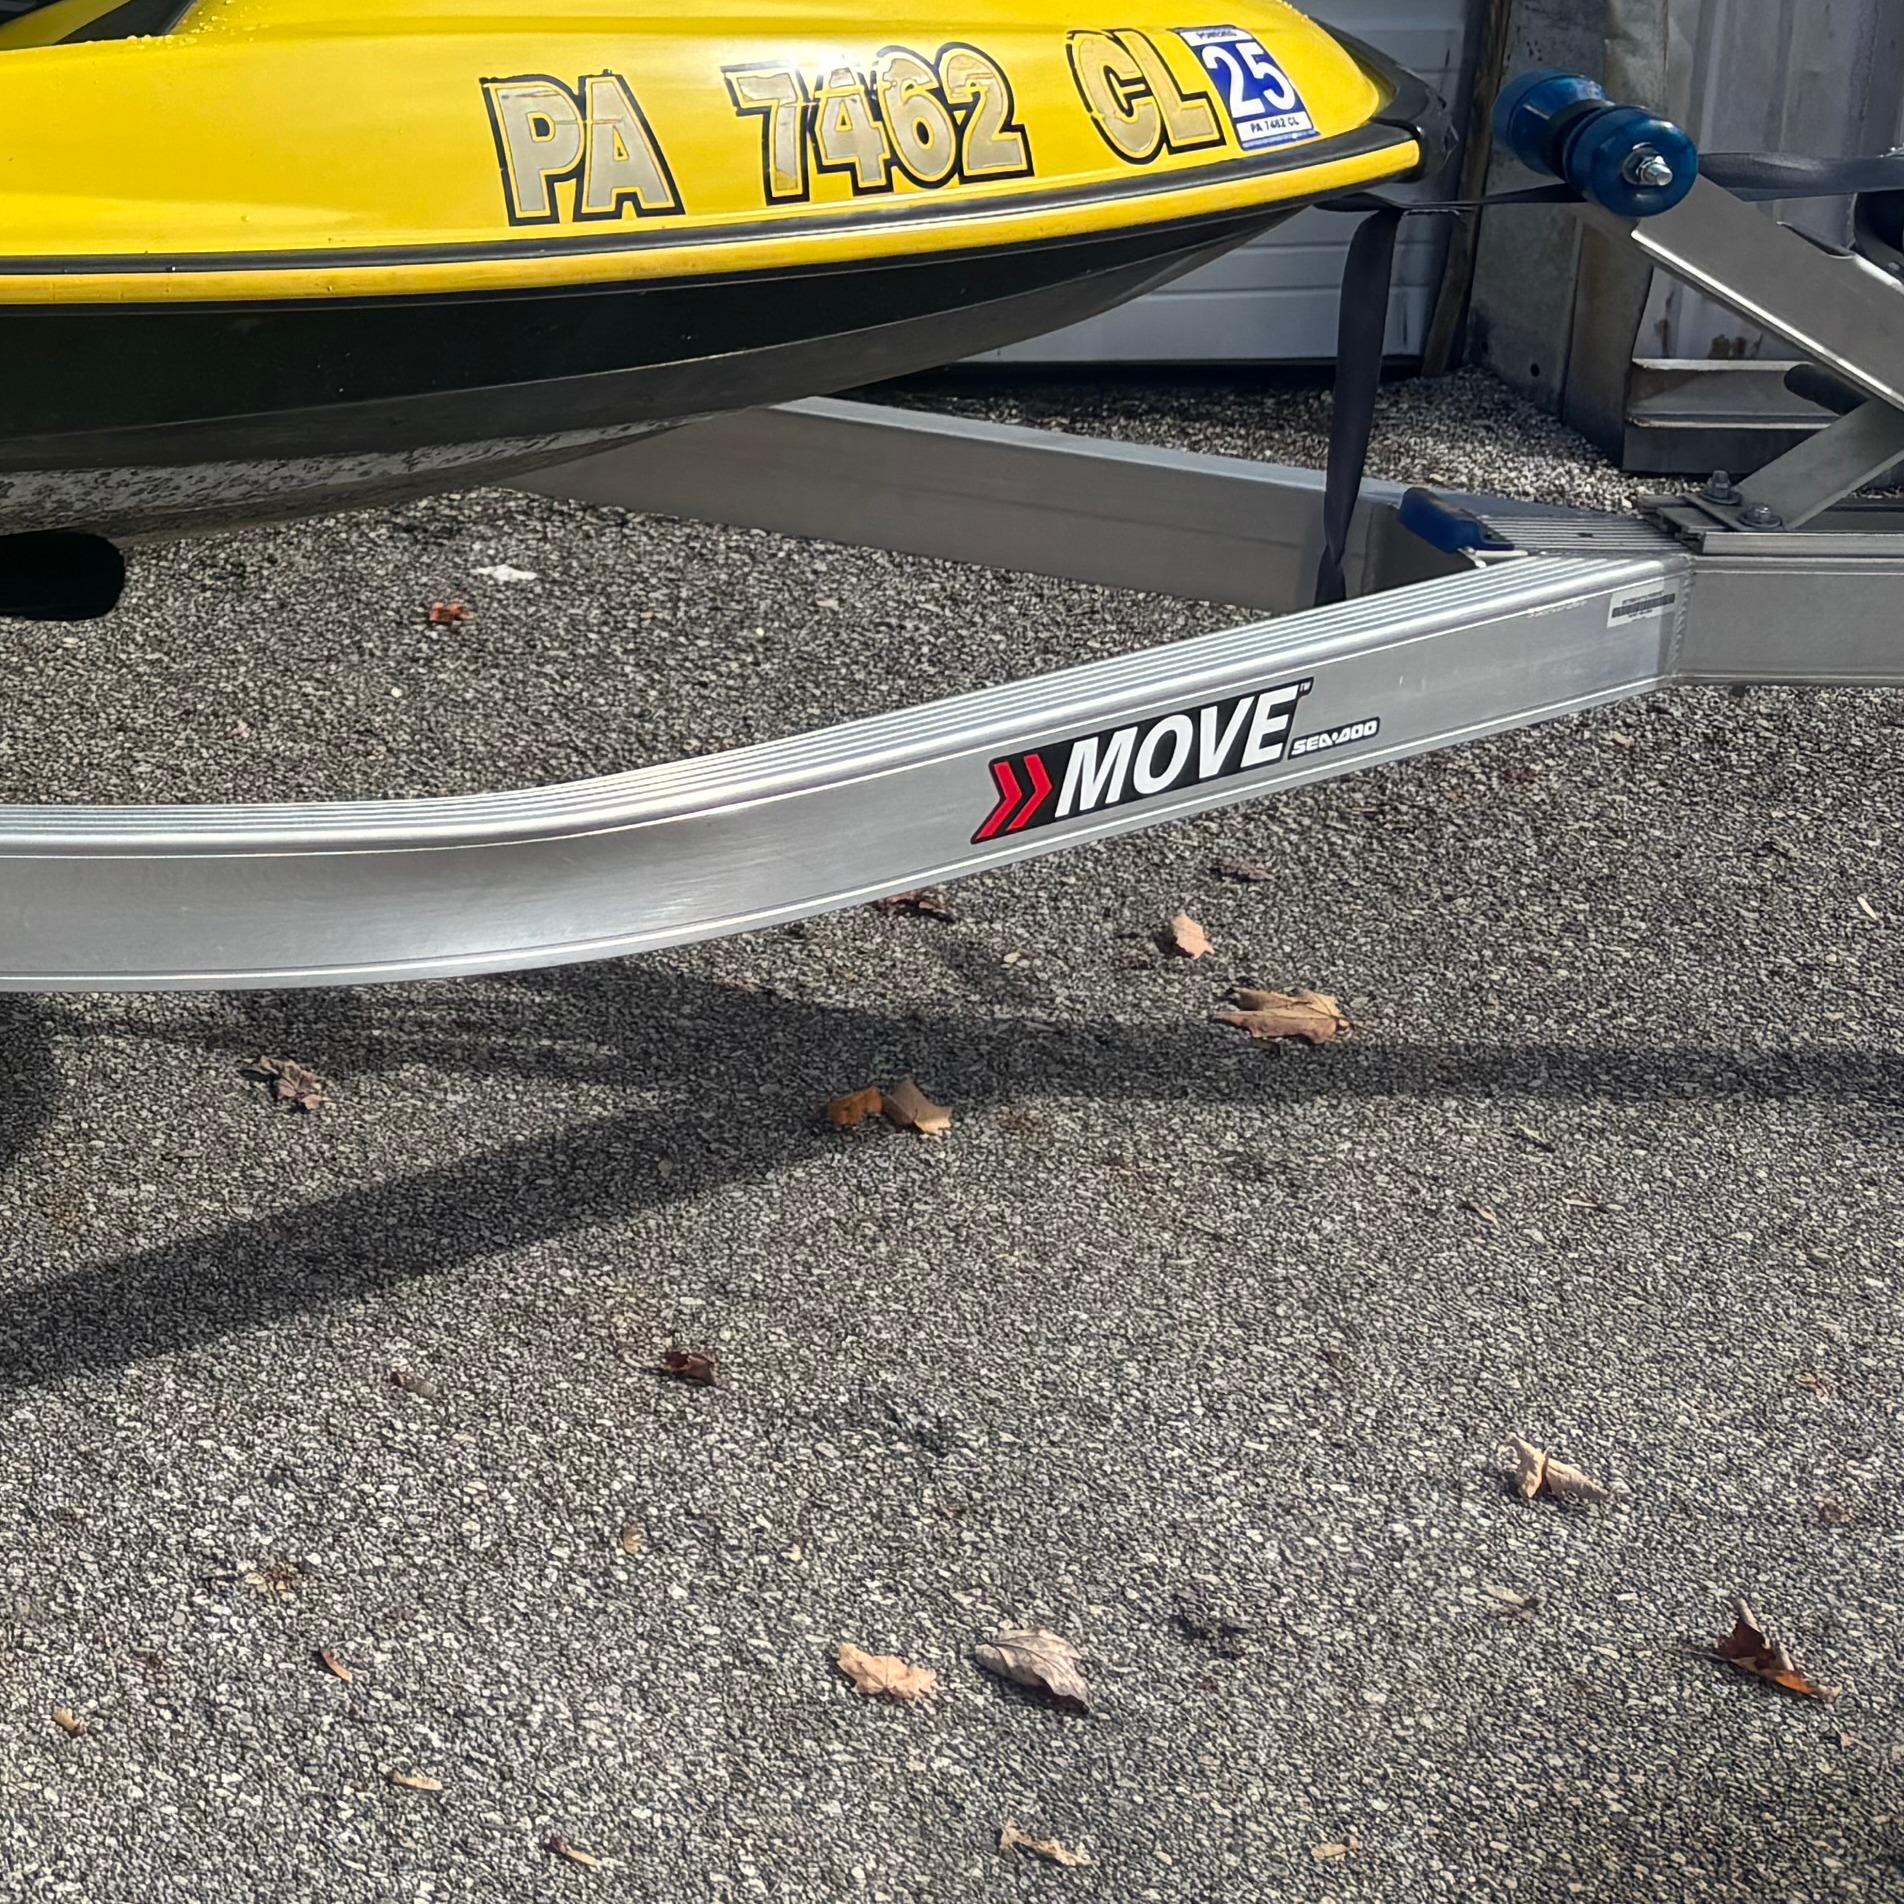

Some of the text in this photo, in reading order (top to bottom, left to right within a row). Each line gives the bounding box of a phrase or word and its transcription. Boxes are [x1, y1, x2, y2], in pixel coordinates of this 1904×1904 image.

[480, 28, 1227, 227] PA 7462 CL
[1201, 41, 1296, 119] 25
[1249, 122, 1264, 134] PA
[1054, 684, 1299, 819] MOVE
